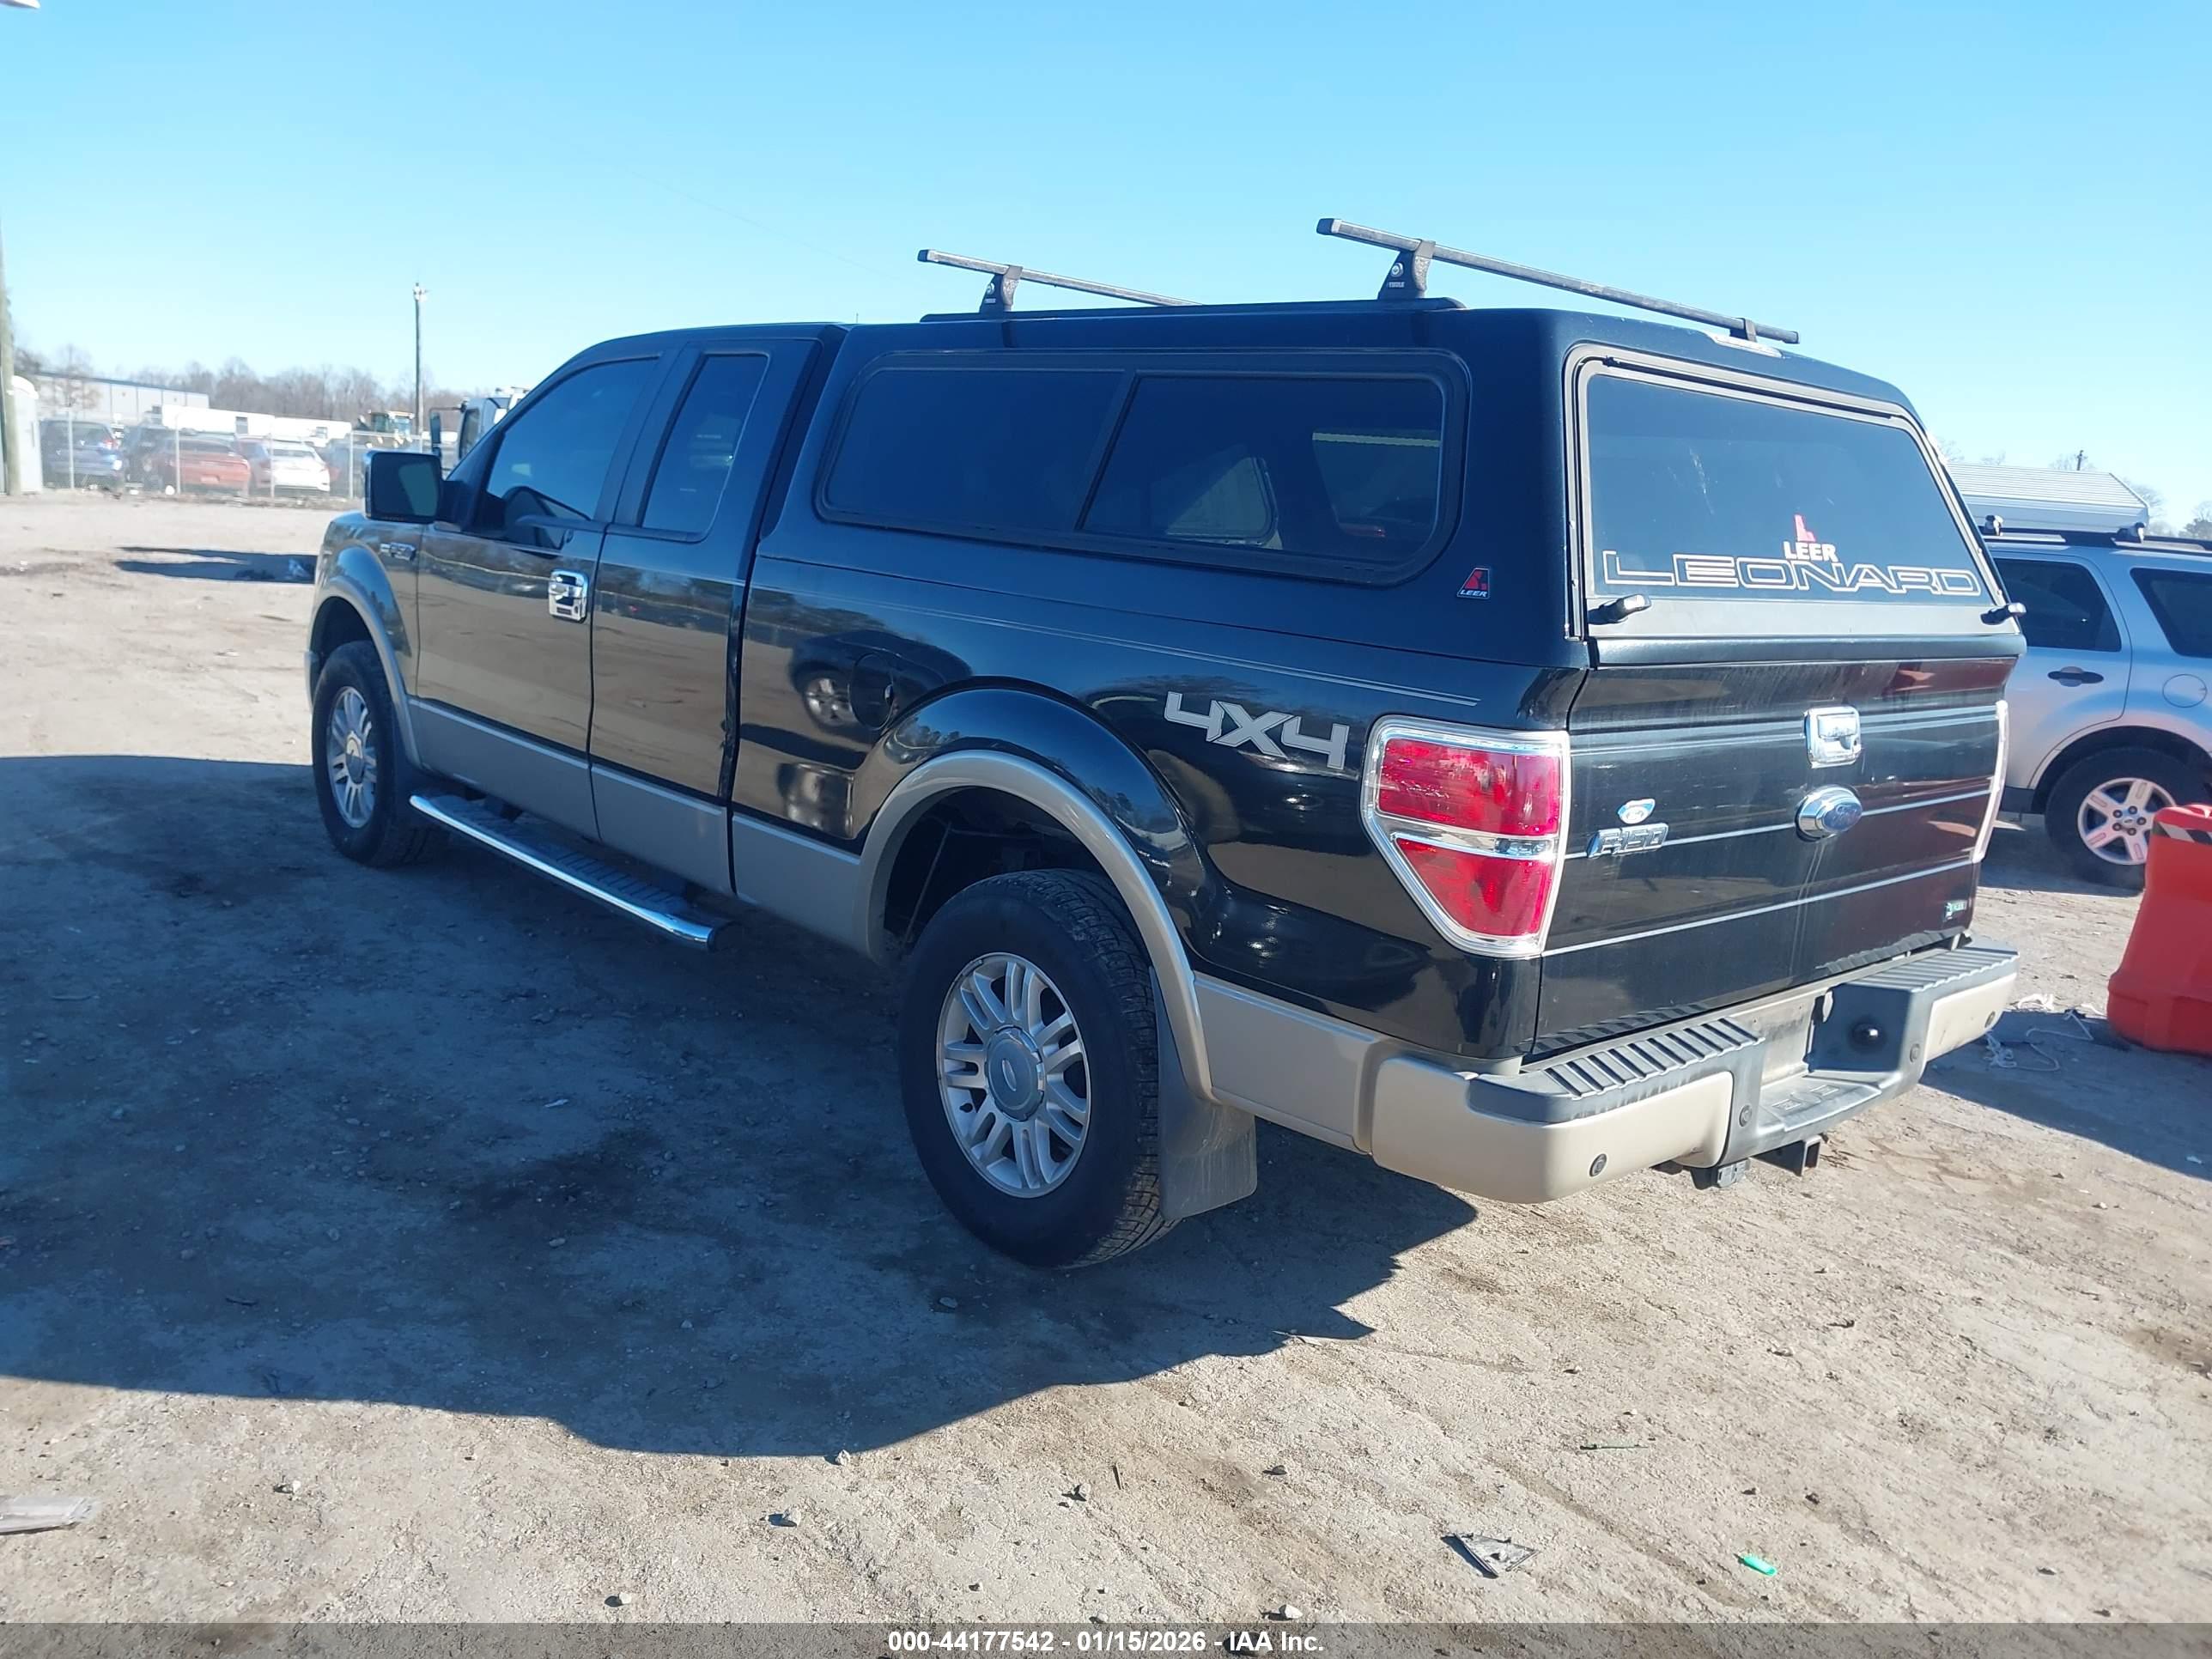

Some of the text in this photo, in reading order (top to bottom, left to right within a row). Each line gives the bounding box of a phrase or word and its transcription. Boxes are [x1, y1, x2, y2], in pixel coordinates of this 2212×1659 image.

[1783, 540, 1839, 562] LEER
[1602, 550, 1982, 597] LEONARD
[1460, 589, 1488, 598] LEER
